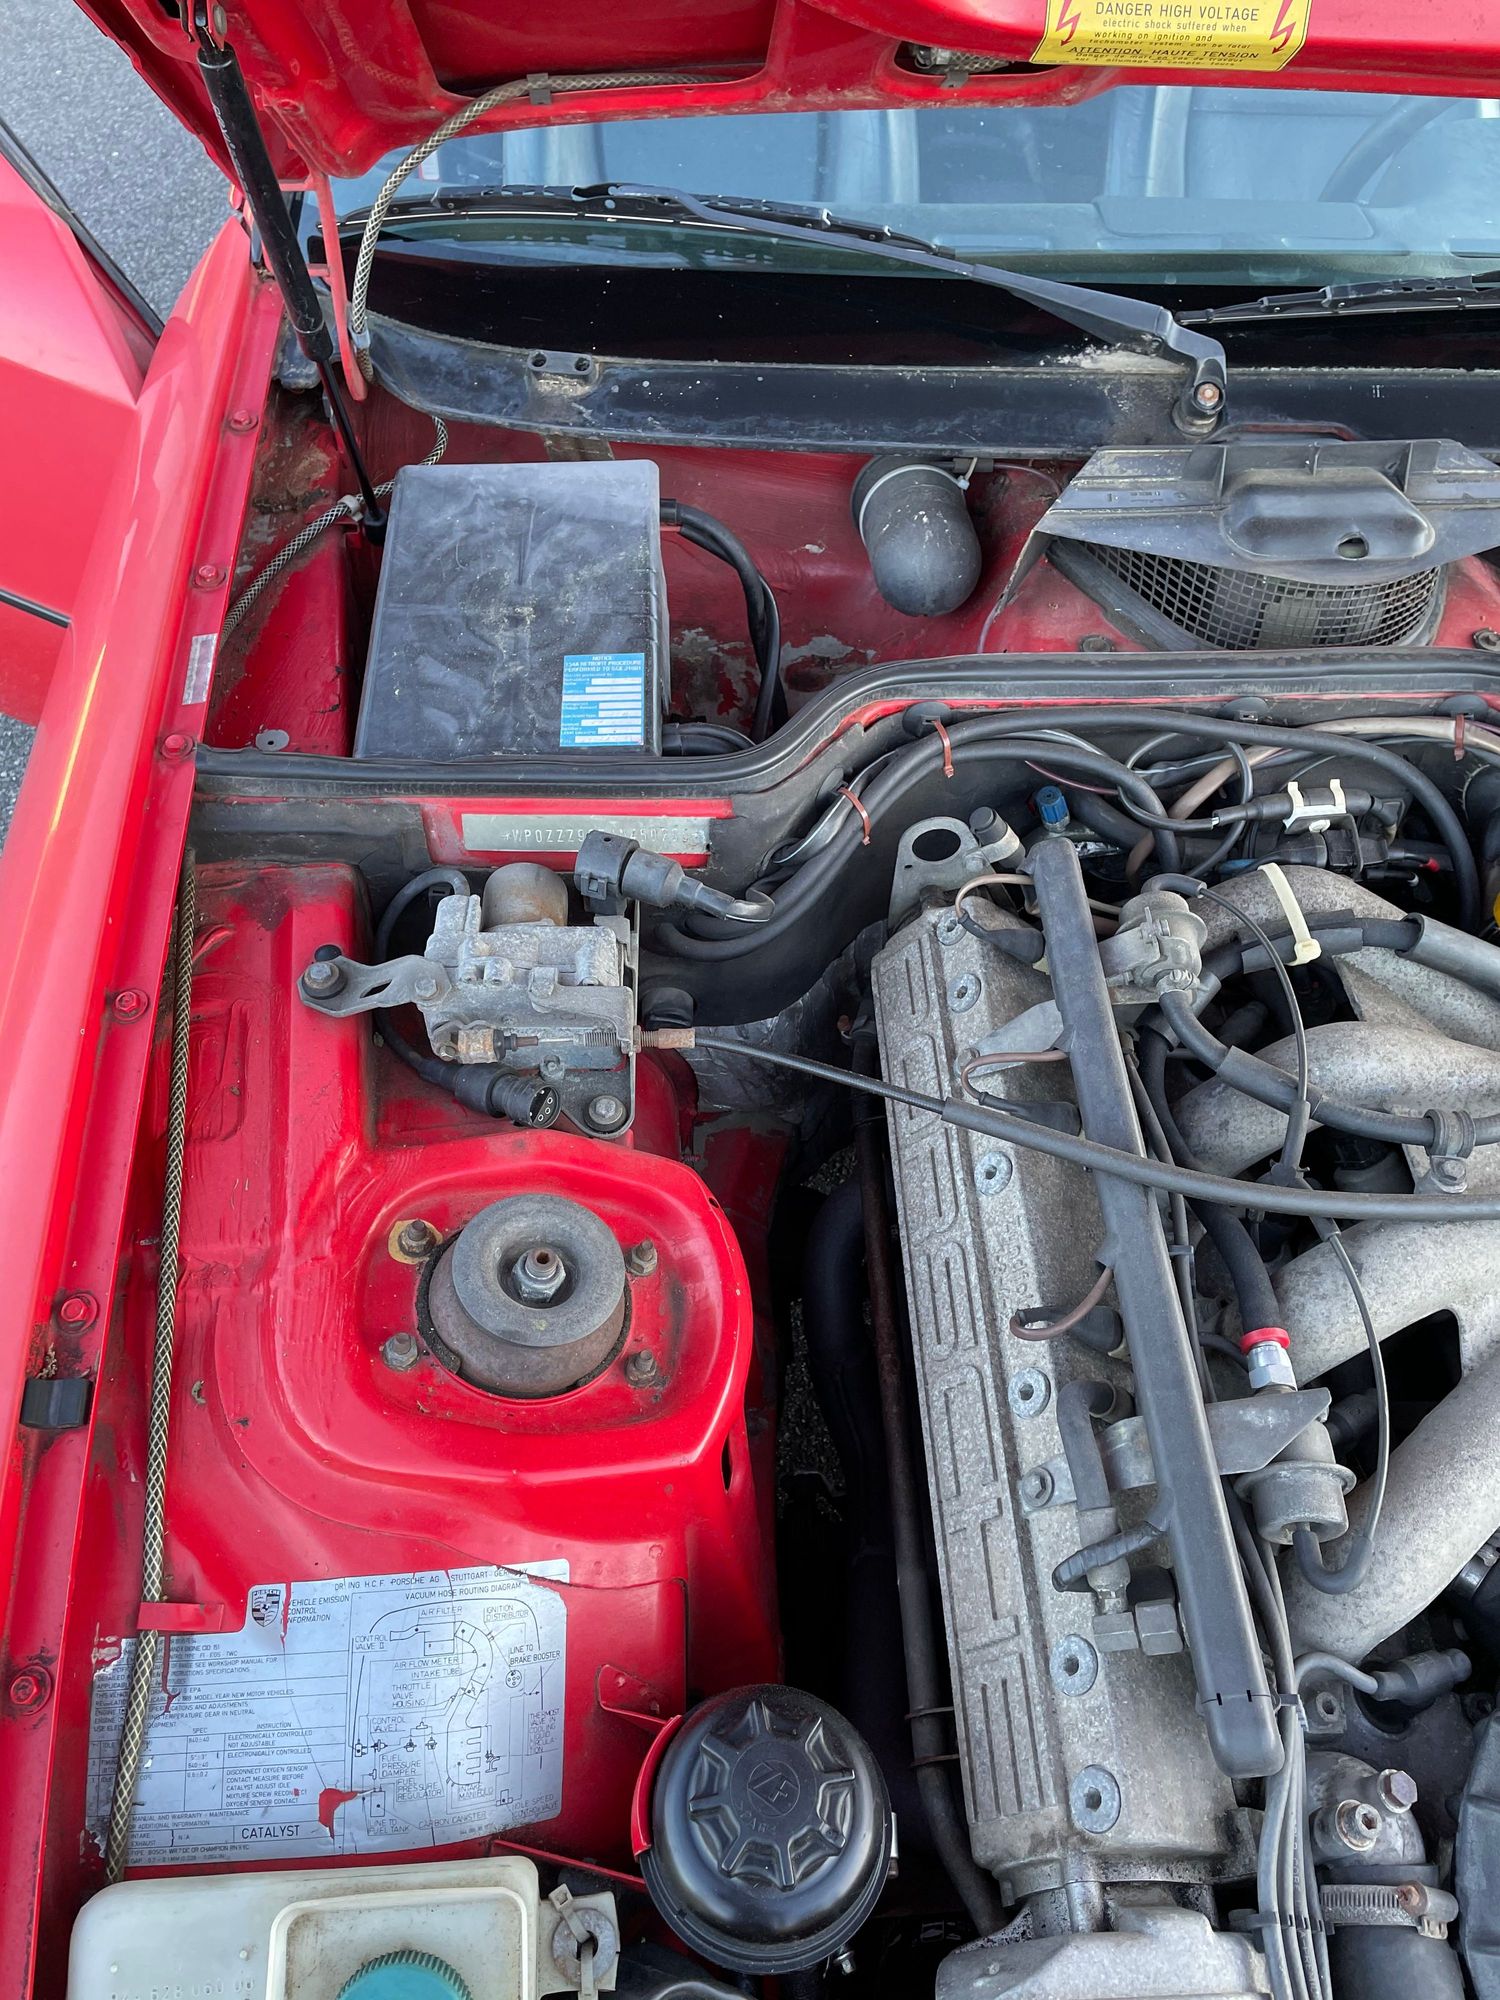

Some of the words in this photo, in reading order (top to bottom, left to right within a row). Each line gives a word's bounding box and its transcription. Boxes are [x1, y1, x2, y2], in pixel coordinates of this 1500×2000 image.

[1096, 2, 1152, 16] DANGER
[1159, 4, 1192, 18] HIGH
[1199, 6, 1260, 21] VOLTAGE
[1103, 18, 1140, 28] electric
[1144, 20, 1171, 29] shock
[1177, 21, 1217, 31] suffered
[1222, 22, 1247, 32] when
[1094, 31, 1132, 40] working
[1154, 32, 1190, 41] ignition
[1195, 34, 1213, 42] and
[1067, 46, 1142, 54] ATTENTION
[1202, 51, 1260, 59] TENSION
[879, 940, 1053, 1812] PORSCHE
[391, 1576, 424, 1585] PORSCHE
[451, 1572, 488, 1581] STUTTGART
[405, 1590, 436, 1600] VACUUM
[438, 1588, 457, 1597] HOSE
[459, 1585, 489, 1595] ROUTING
[491, 1582, 521, 1592] DIAGRAM
[282, 1599, 316, 1607] VEHICLE
[318, 1595, 350, 1604] EMISSION
[281, 1607, 317, 1616] CONTROL
[421, 1608, 433, 1616] AIR
[436, 1606, 462, 1615] FILTER
[486, 1604, 513, 1613] IGNITION
[486, 1609, 528, 1620] DISTRIBUTOR
[281, 1615, 330, 1624] INFORMATION
[355, 1635, 387, 1643] CONTROL
[510, 1646, 524, 1654] LINE
[431, 1657, 458, 1665] METER
[510, 1655, 532, 1665] BRAKE
[533, 1650, 560, 1661] BOOSTER
[411, 1670, 441, 1678] INTAKE
[392, 1682, 431, 1691] THROTTLE
[266, 1688, 294, 1696] VEHICLES
[392, 1692, 414, 1700] VALVE
[208, 1701, 249, 1709] ADJUSTMENTS
[392, 1699, 426, 1707] HOUSING
[163, 1712, 204, 1720] TEMPERATURE
[372, 1716, 406, 1724] CONTROL
[374, 1724, 393, 1732] VALVE
[228, 1732, 275, 1740] ELECTRONICALLY
[276, 1730, 313, 1738] CONTROLLED
[228, 1750, 275, 1758] ELECTRONICALLY
[382, 1754, 401, 1762] FUEL
[382, 1760, 421, 1769] PRESSURE
[226, 1768, 261, 1776] DISCONNECT
[382, 1769, 417, 1777] DAMPER
[397, 1782, 438, 1792] PRESSURE
[397, 1789, 442, 1800] REGULATOR
[460, 1787, 494, 1799] MANIFOLD
[172, 1820, 210, 1828] INFORMATION
[369, 1819, 387, 1827] LINE
[389, 1818, 397, 1826] TO
[419, 1818, 450, 1828] CARBON
[241, 1824, 300, 1840] CATALYST
